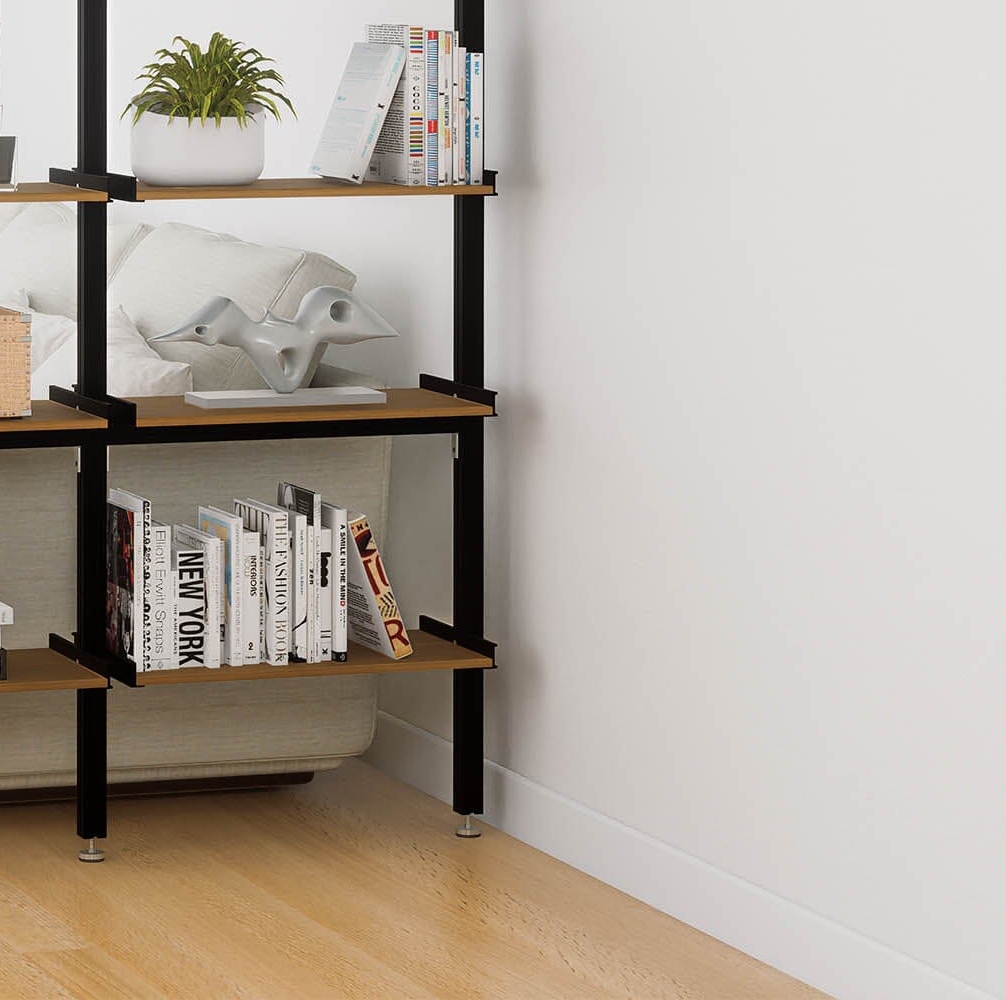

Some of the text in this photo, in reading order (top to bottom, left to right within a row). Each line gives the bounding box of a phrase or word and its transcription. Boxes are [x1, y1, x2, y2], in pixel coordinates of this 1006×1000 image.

[152, 529, 167, 655] Elliott Erwitt Snaps
[178, 552, 205, 666] NEW YORK
[275, 514, 287, 663] THE FASHION BOOK
[339, 558, 346, 567] IN
